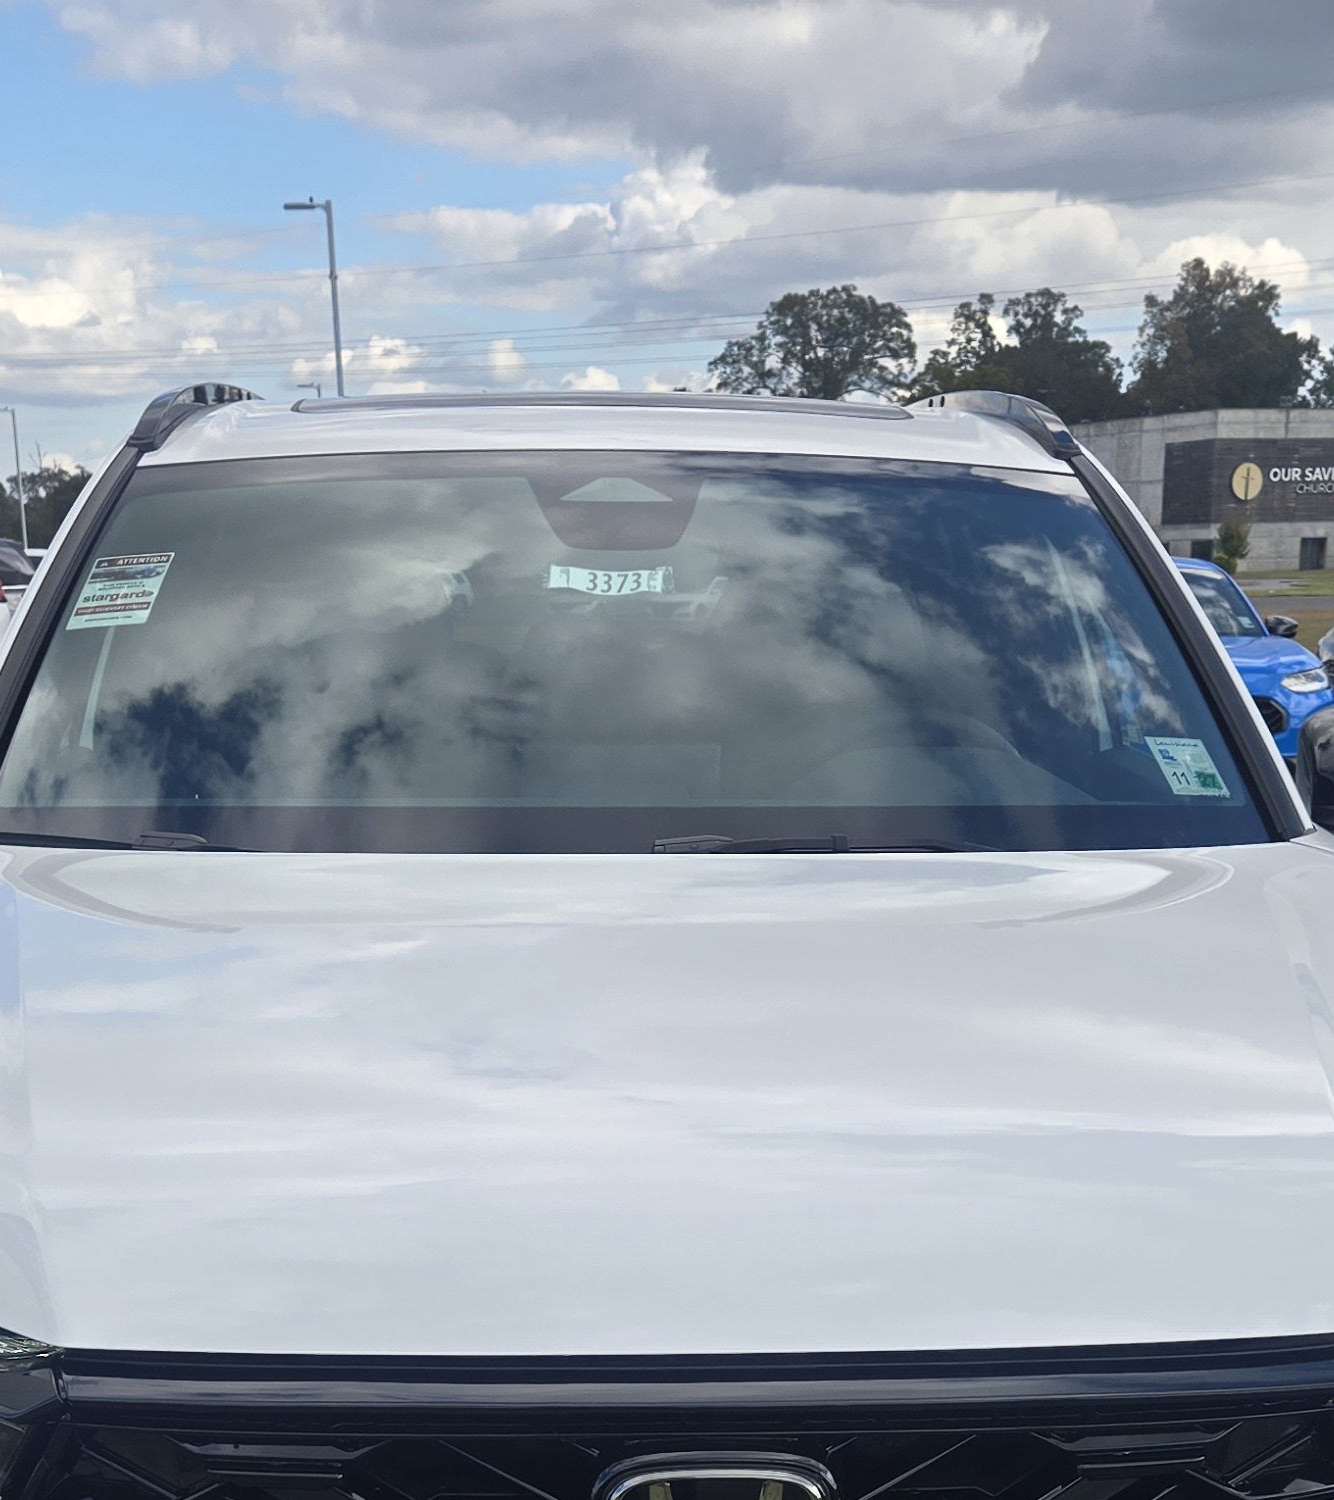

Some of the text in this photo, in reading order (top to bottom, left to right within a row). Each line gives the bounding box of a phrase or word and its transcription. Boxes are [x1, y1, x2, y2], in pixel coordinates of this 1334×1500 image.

[1269, 467, 1301, 482] OUR
[116, 555, 169, 566] ATTENTION
[586, 571, 642, 594] 3373
[82, 589, 147, 603] stargard
[1171, 771, 1191, 786] 11
